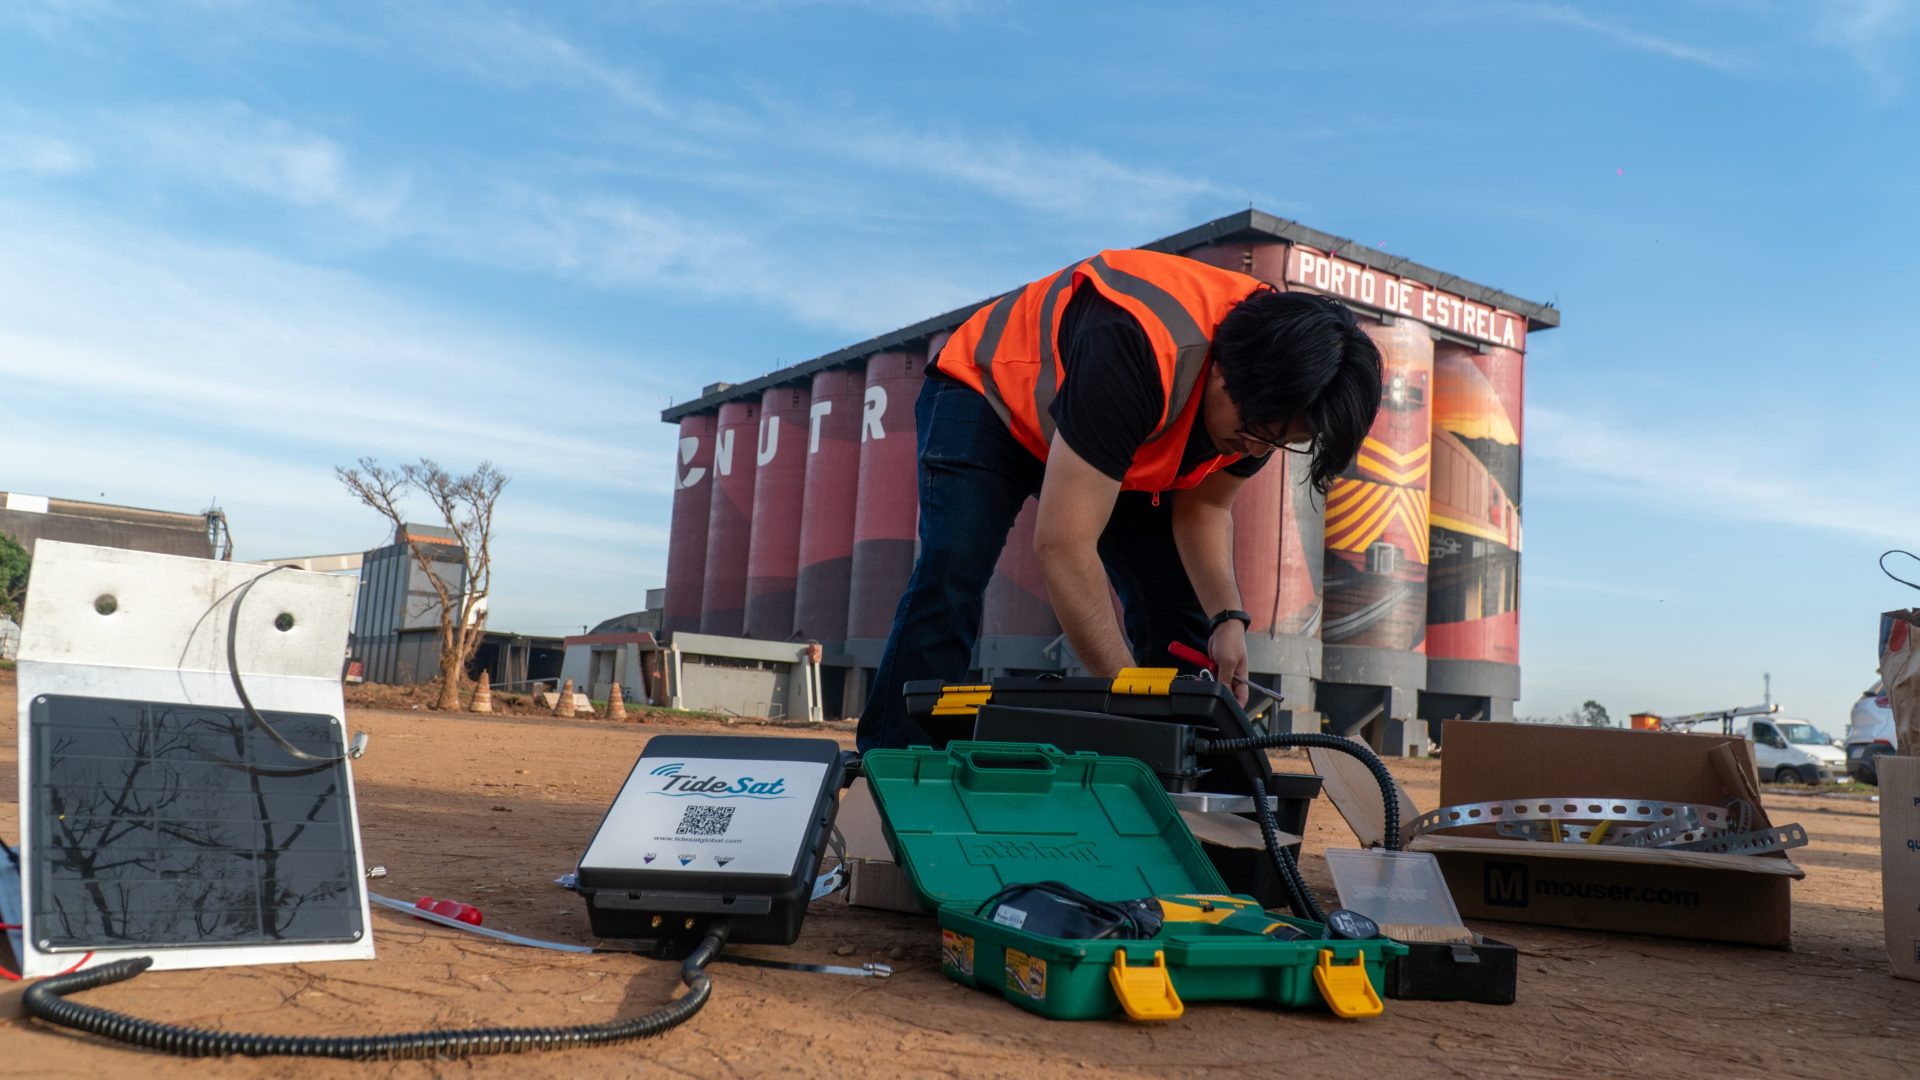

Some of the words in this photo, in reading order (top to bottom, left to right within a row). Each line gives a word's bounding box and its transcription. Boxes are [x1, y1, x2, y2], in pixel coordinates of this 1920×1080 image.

[1300, 252, 1375, 303] PORTO
[1385, 278, 1413, 316] DE
[1422, 290, 1516, 348] ESTRELA
[662, 774, 786, 795] TideSat
[653, 836, 743, 845] www.tidesatglobal.com
[1535, 879, 1700, 906] mouser.com
